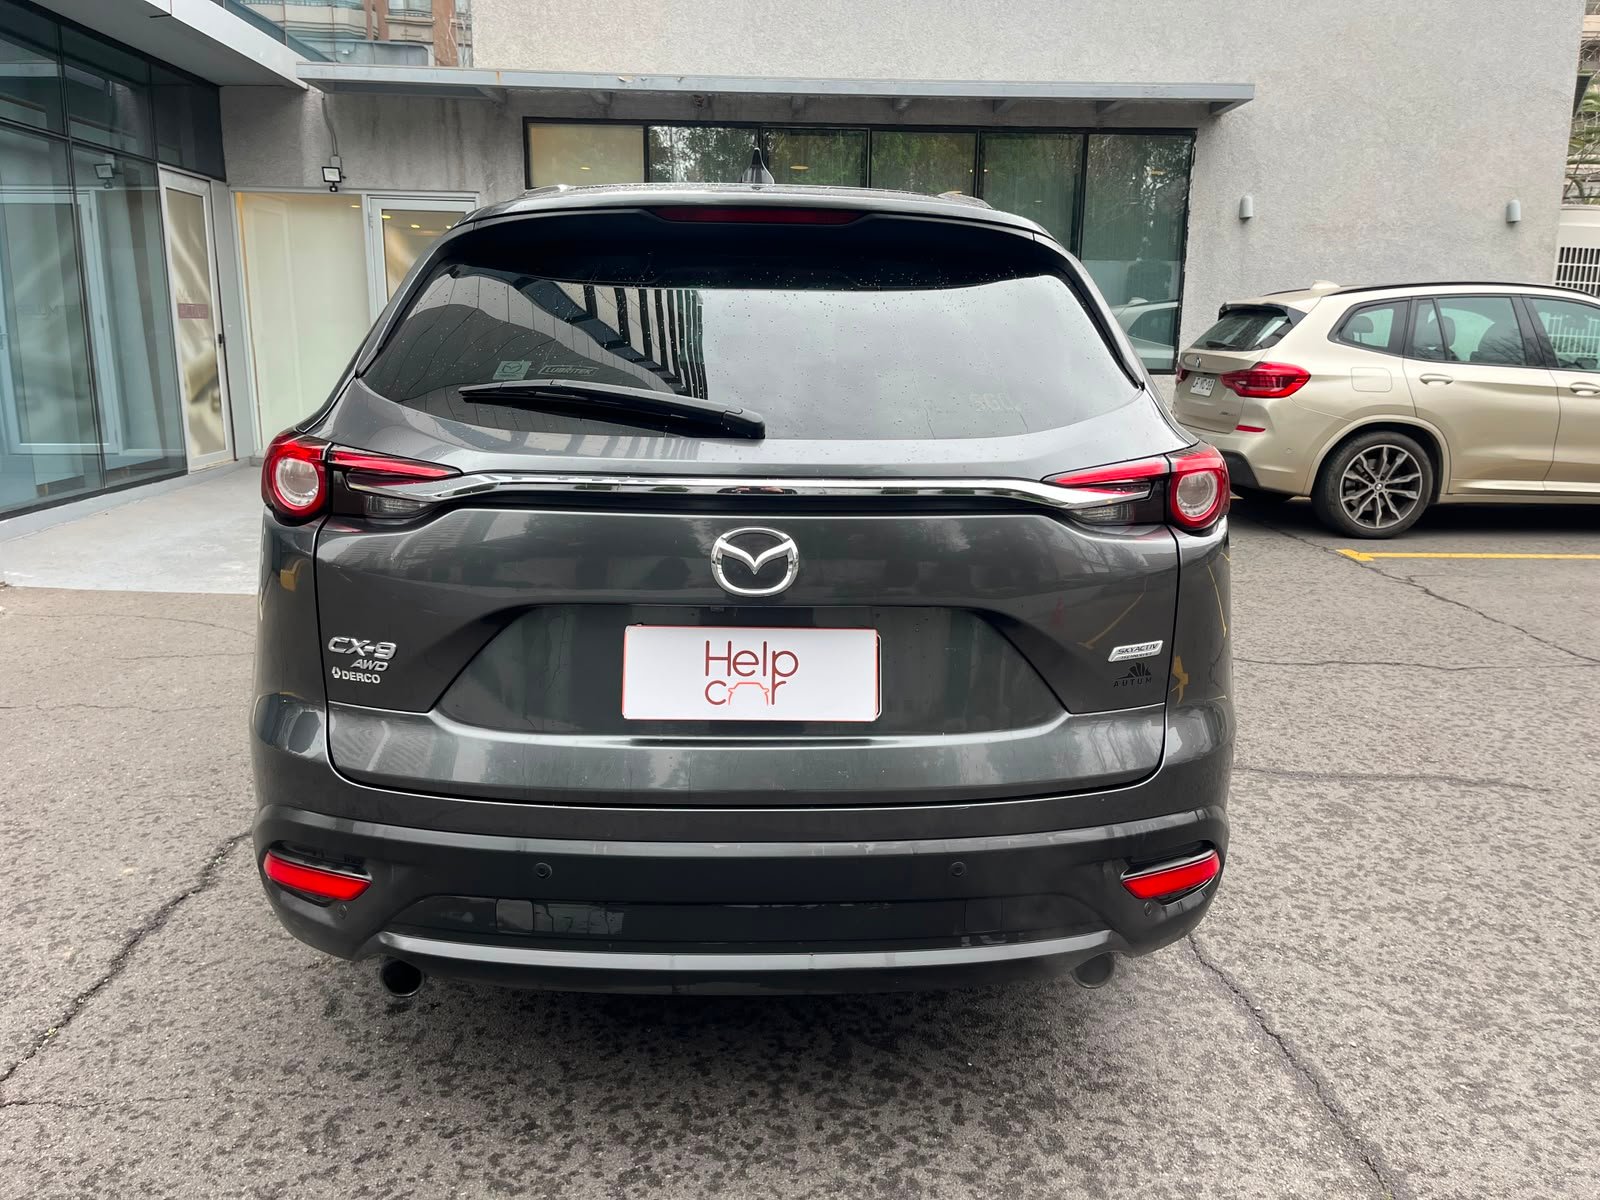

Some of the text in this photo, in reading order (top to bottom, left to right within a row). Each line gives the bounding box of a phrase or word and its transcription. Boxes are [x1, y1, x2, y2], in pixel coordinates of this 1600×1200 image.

[328, 636, 397, 659] CX-9
[1118, 643, 1158, 655] SKYACTIV
[350, 659, 388, 671] AWD
[704, 640, 799, 681] Help
[342, 671, 381, 683] DERCO
[1113, 677, 1152, 687] AUTUM
